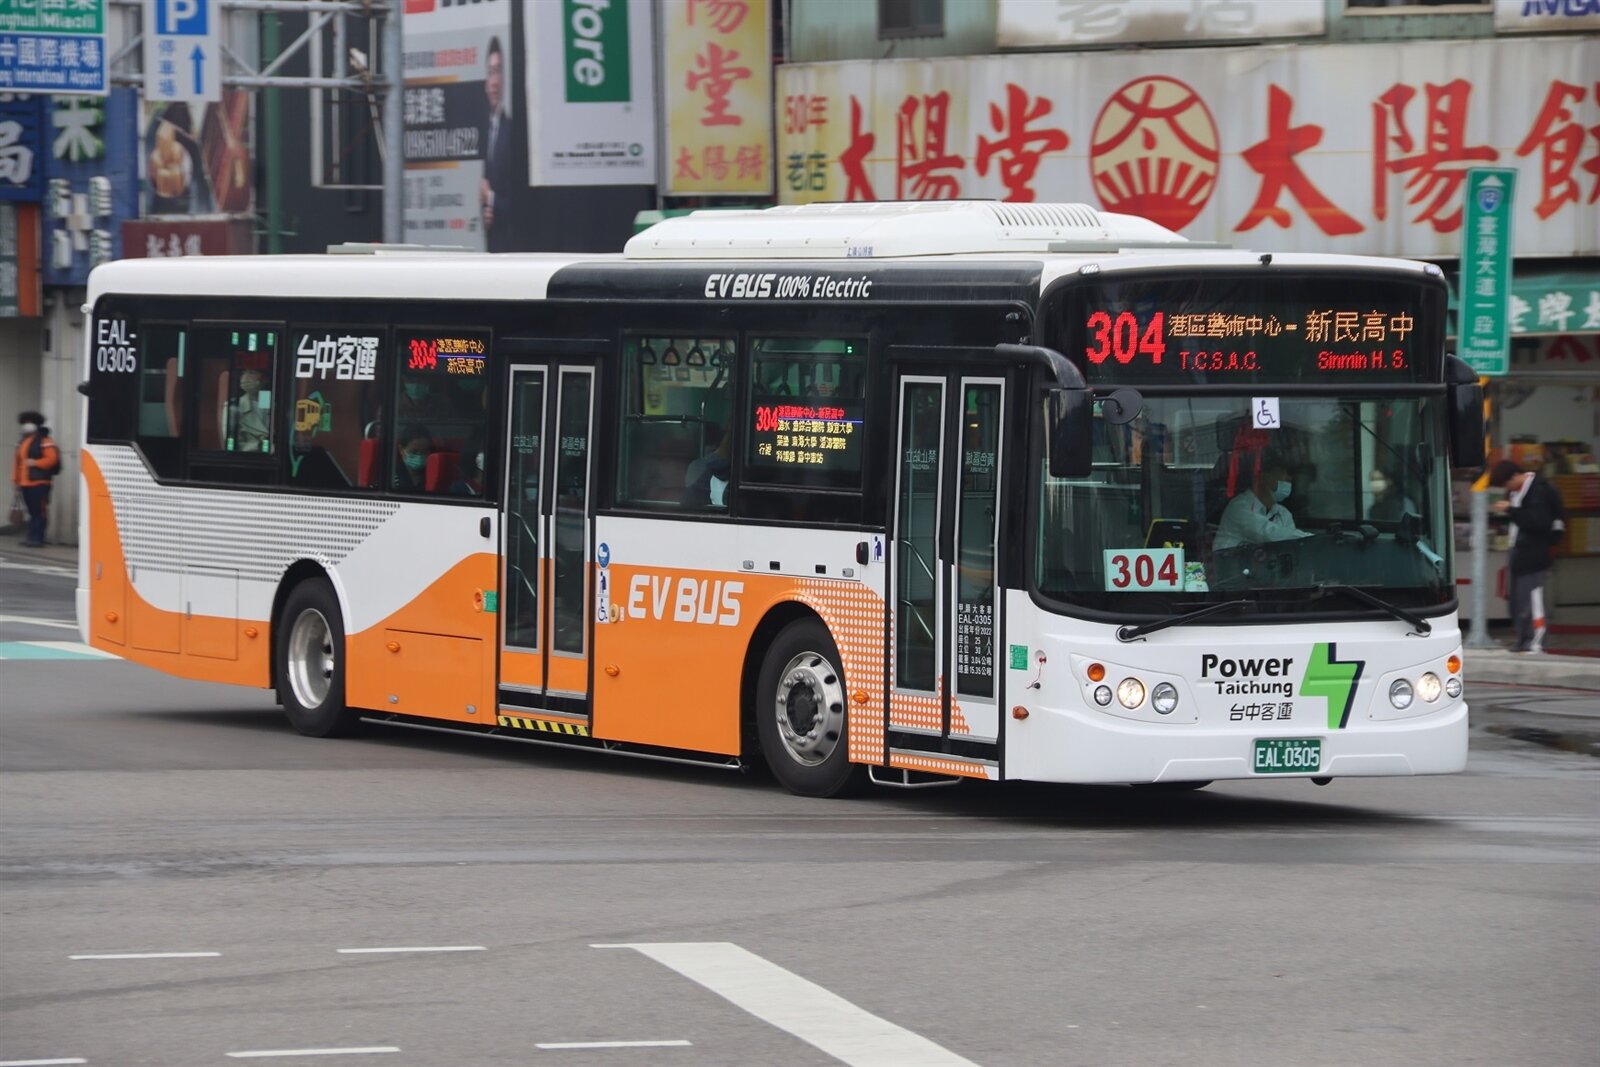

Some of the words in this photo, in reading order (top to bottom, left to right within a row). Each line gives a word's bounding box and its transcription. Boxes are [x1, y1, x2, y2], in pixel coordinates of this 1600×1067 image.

[704, 273, 734, 298] EV
[731, 273, 777, 298] BUS
[774, 275, 812, 299] 100%
[811, 275, 873, 298] Electric
[1085, 311, 1166, 364] 304
[1305, 309, 1415, 342] 新民高中
[97, 346, 136, 374] 0305
[295, 334, 380, 381] 台中客運
[755, 406, 779, 432] 304
[1111, 553, 1179, 588] 304
[627, 574, 672, 620] EV
[673, 577, 745, 627] BUS
[958, 614, 992, 625] EAL-0305
[986, 636, 992, 646] 人
[986, 646, 992, 656] 人
[1201, 653, 1293, 678] Power
[1214, 681, 1293, 698] Taichung
[1229, 702, 1293, 721] 台中客運
